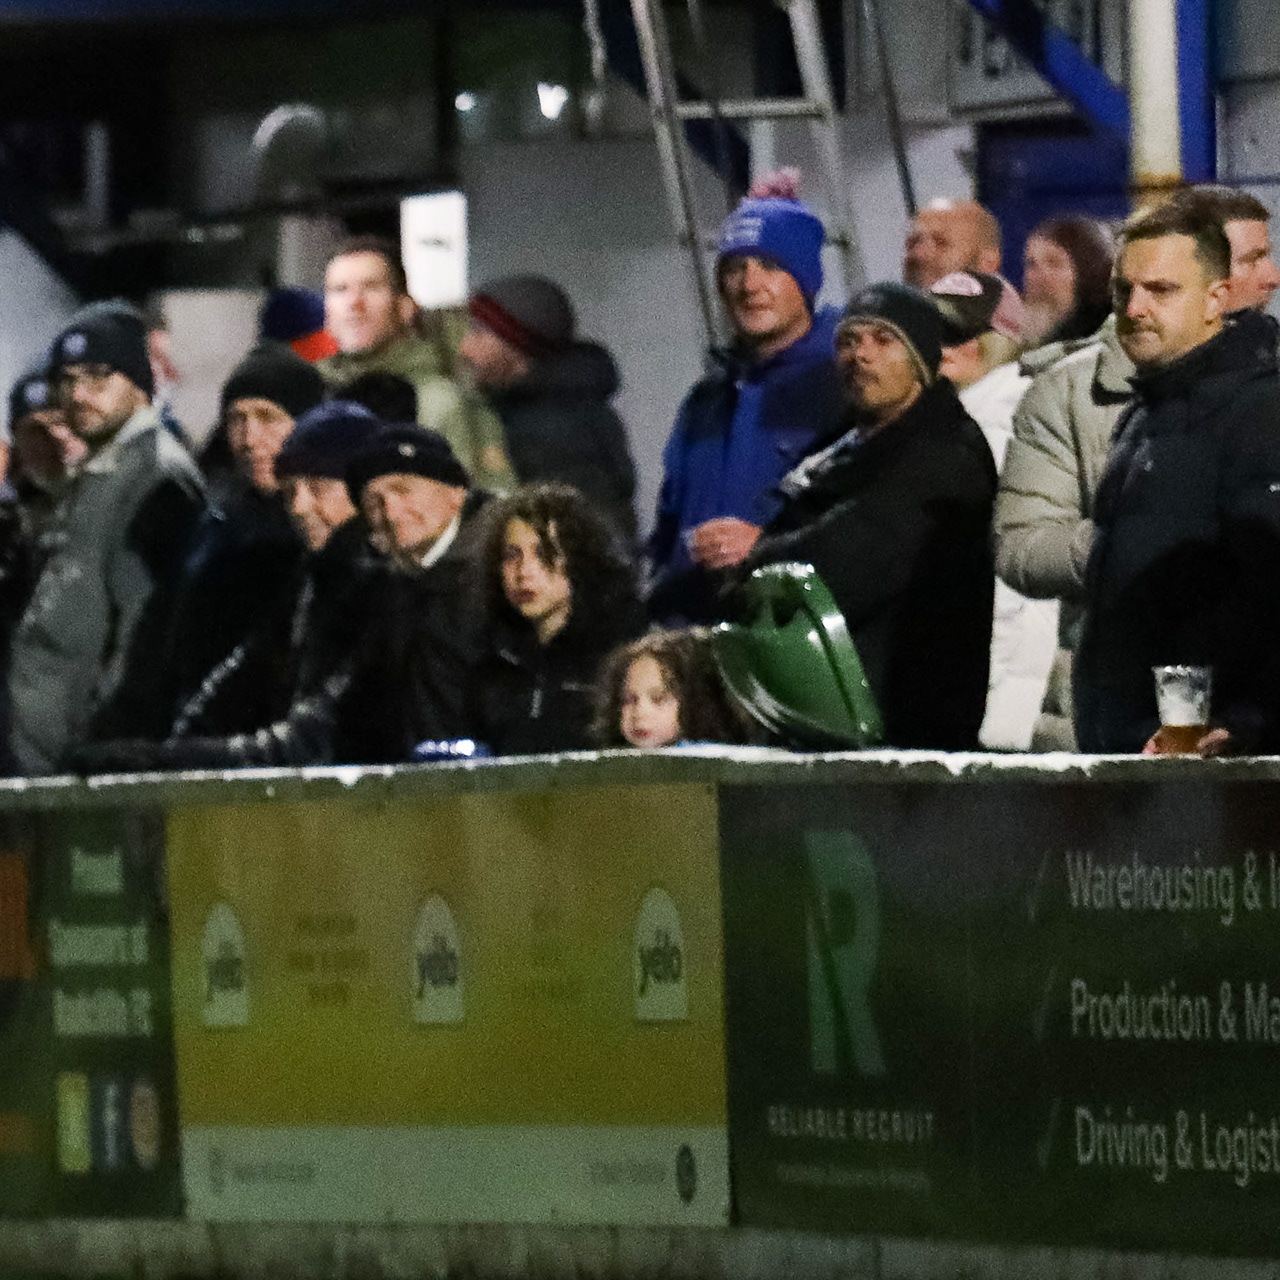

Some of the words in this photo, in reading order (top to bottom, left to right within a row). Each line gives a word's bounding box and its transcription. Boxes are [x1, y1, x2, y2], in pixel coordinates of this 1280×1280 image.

[1065, 849, 1235, 926] Warehousing
[1243, 849, 1262, 911] &
[1070, 978, 1211, 1041] Production
[1218, 978, 1239, 1042] &
[852, 1107, 934, 1143] RECRUIT
[1074, 1105, 1168, 1183] Driving
[1174, 1108, 1194, 1171] &
